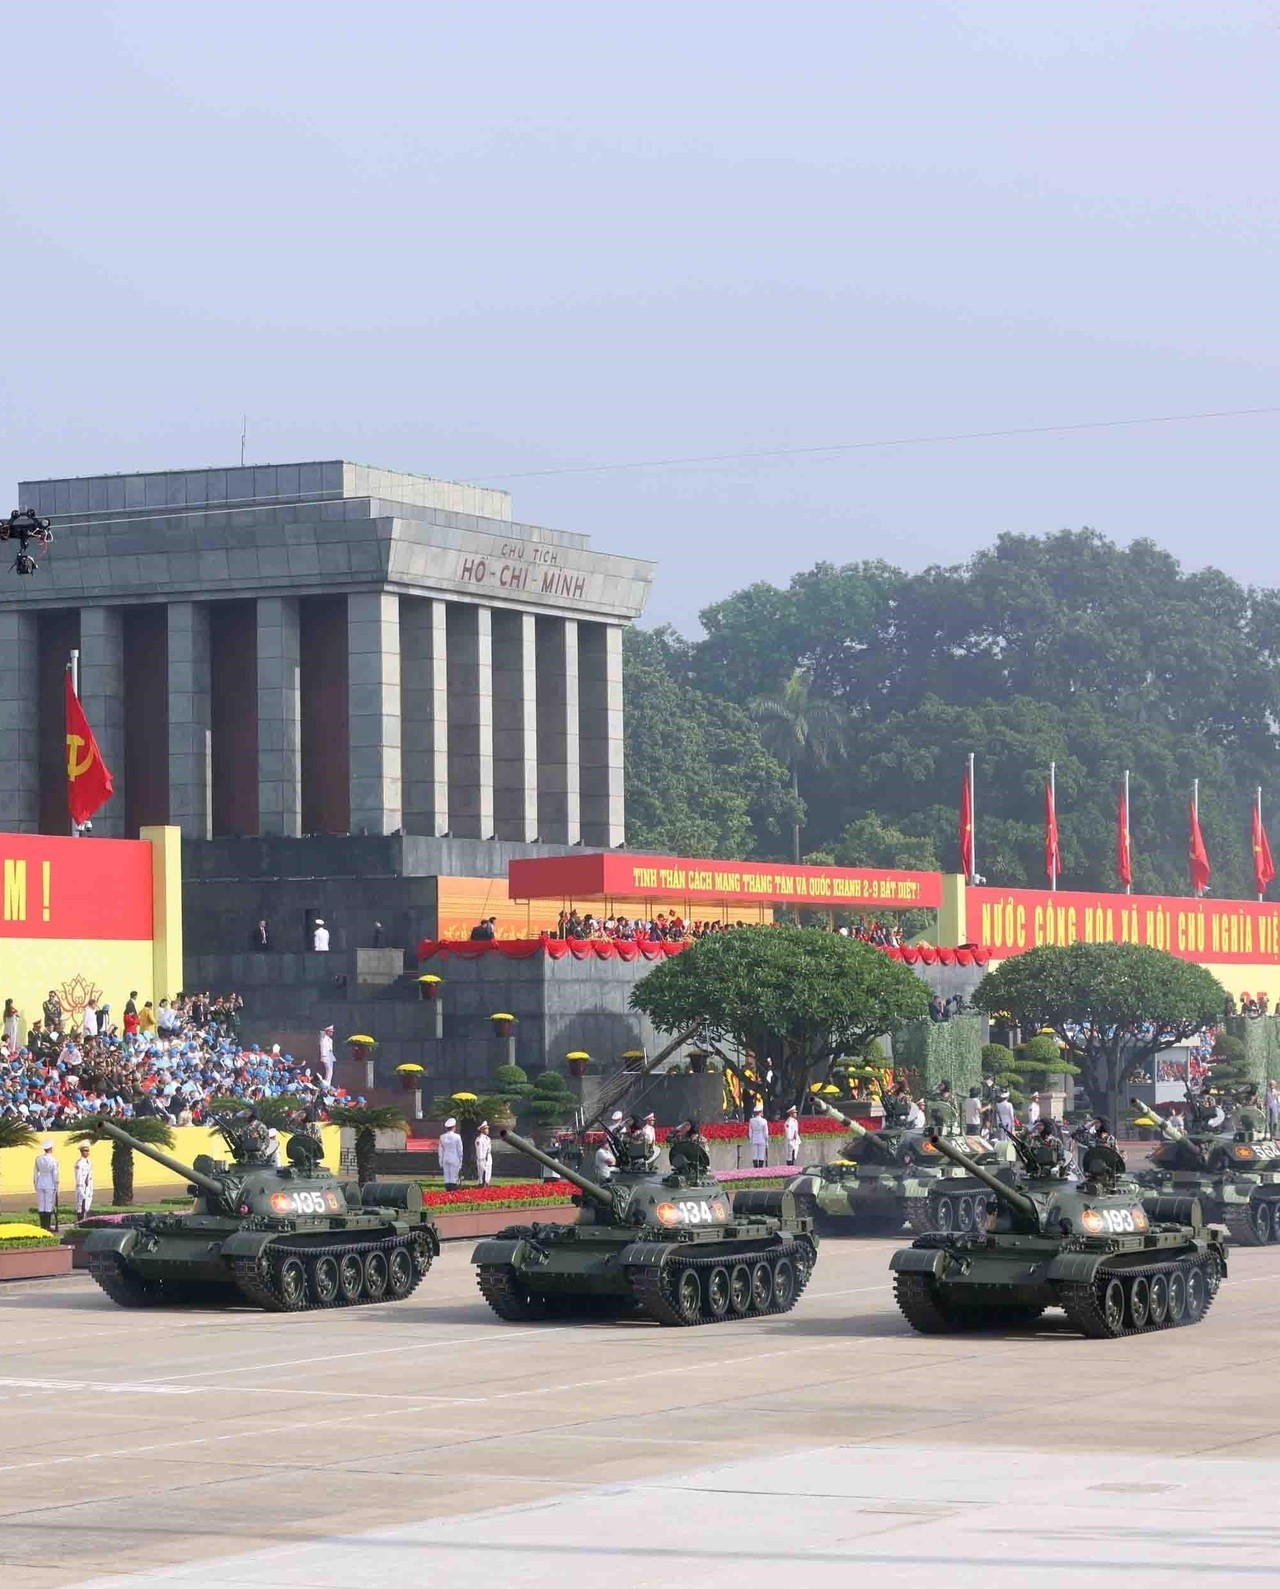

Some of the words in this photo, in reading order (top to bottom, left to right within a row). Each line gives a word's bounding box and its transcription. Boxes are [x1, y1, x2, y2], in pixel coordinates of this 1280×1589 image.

[633, 867, 658, 888] TINH
[688, 866, 713, 890] CÁCH
[715, 872, 740, 895] MẠNG
[742, 871, 773, 894] THÁNG
[775, 871, 794, 895] TÁM
[795, 872, 808, 896] VÀ
[809, 873, 831, 897] QUỐC
[833, 875, 861, 897] KHÁNH
[863, 880, 879, 898] 2-9
[880, 876, 897, 899] BẤT
[982, 896, 1026, 948] NƯỚC
[1178, 903, 1205, 952] CHỦ
[293, 1192, 325, 1213] 135
[679, 1201, 713, 1223] 134
[1102, 1209, 1134, 1232] 193
